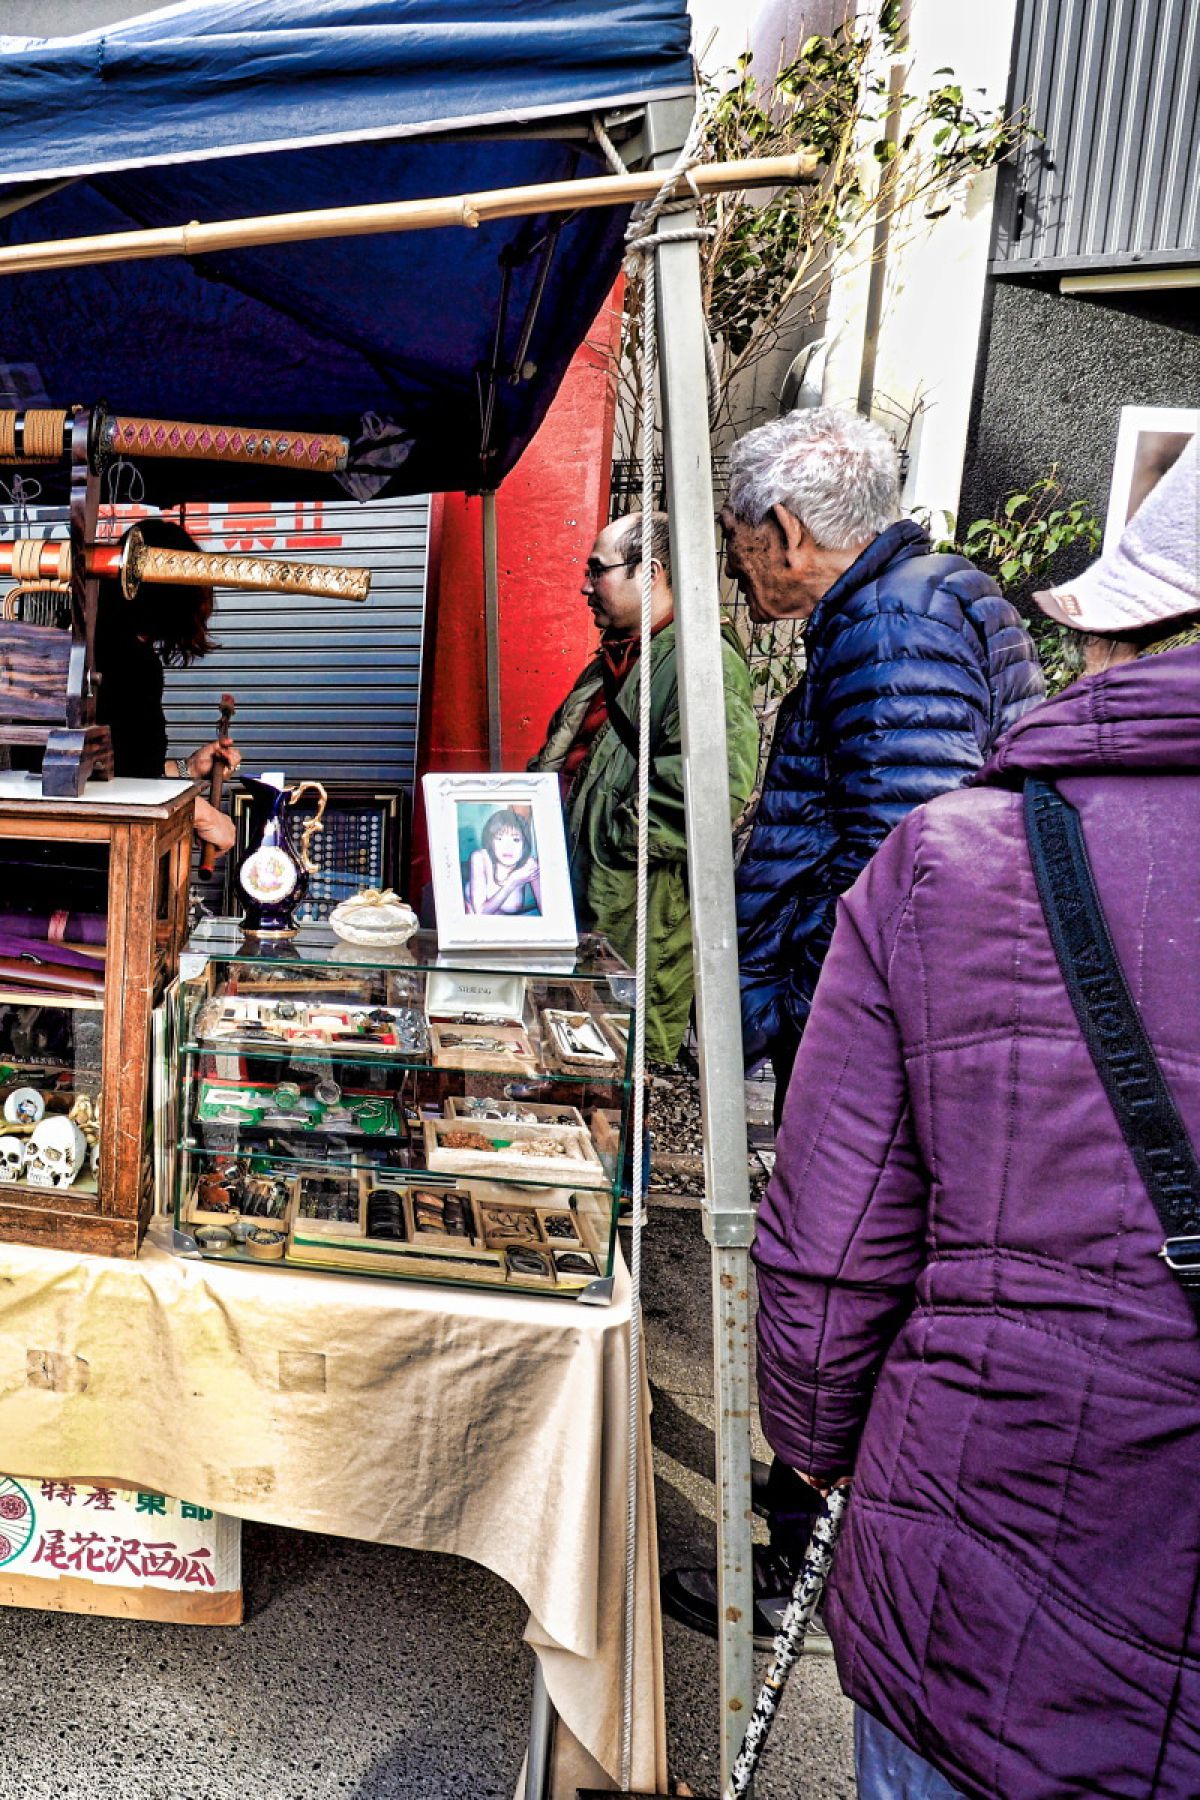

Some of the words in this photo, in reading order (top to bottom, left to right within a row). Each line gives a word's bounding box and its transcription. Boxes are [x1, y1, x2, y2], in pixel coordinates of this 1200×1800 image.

[32, 1529, 216, 1586] 尾花沢西瓜
